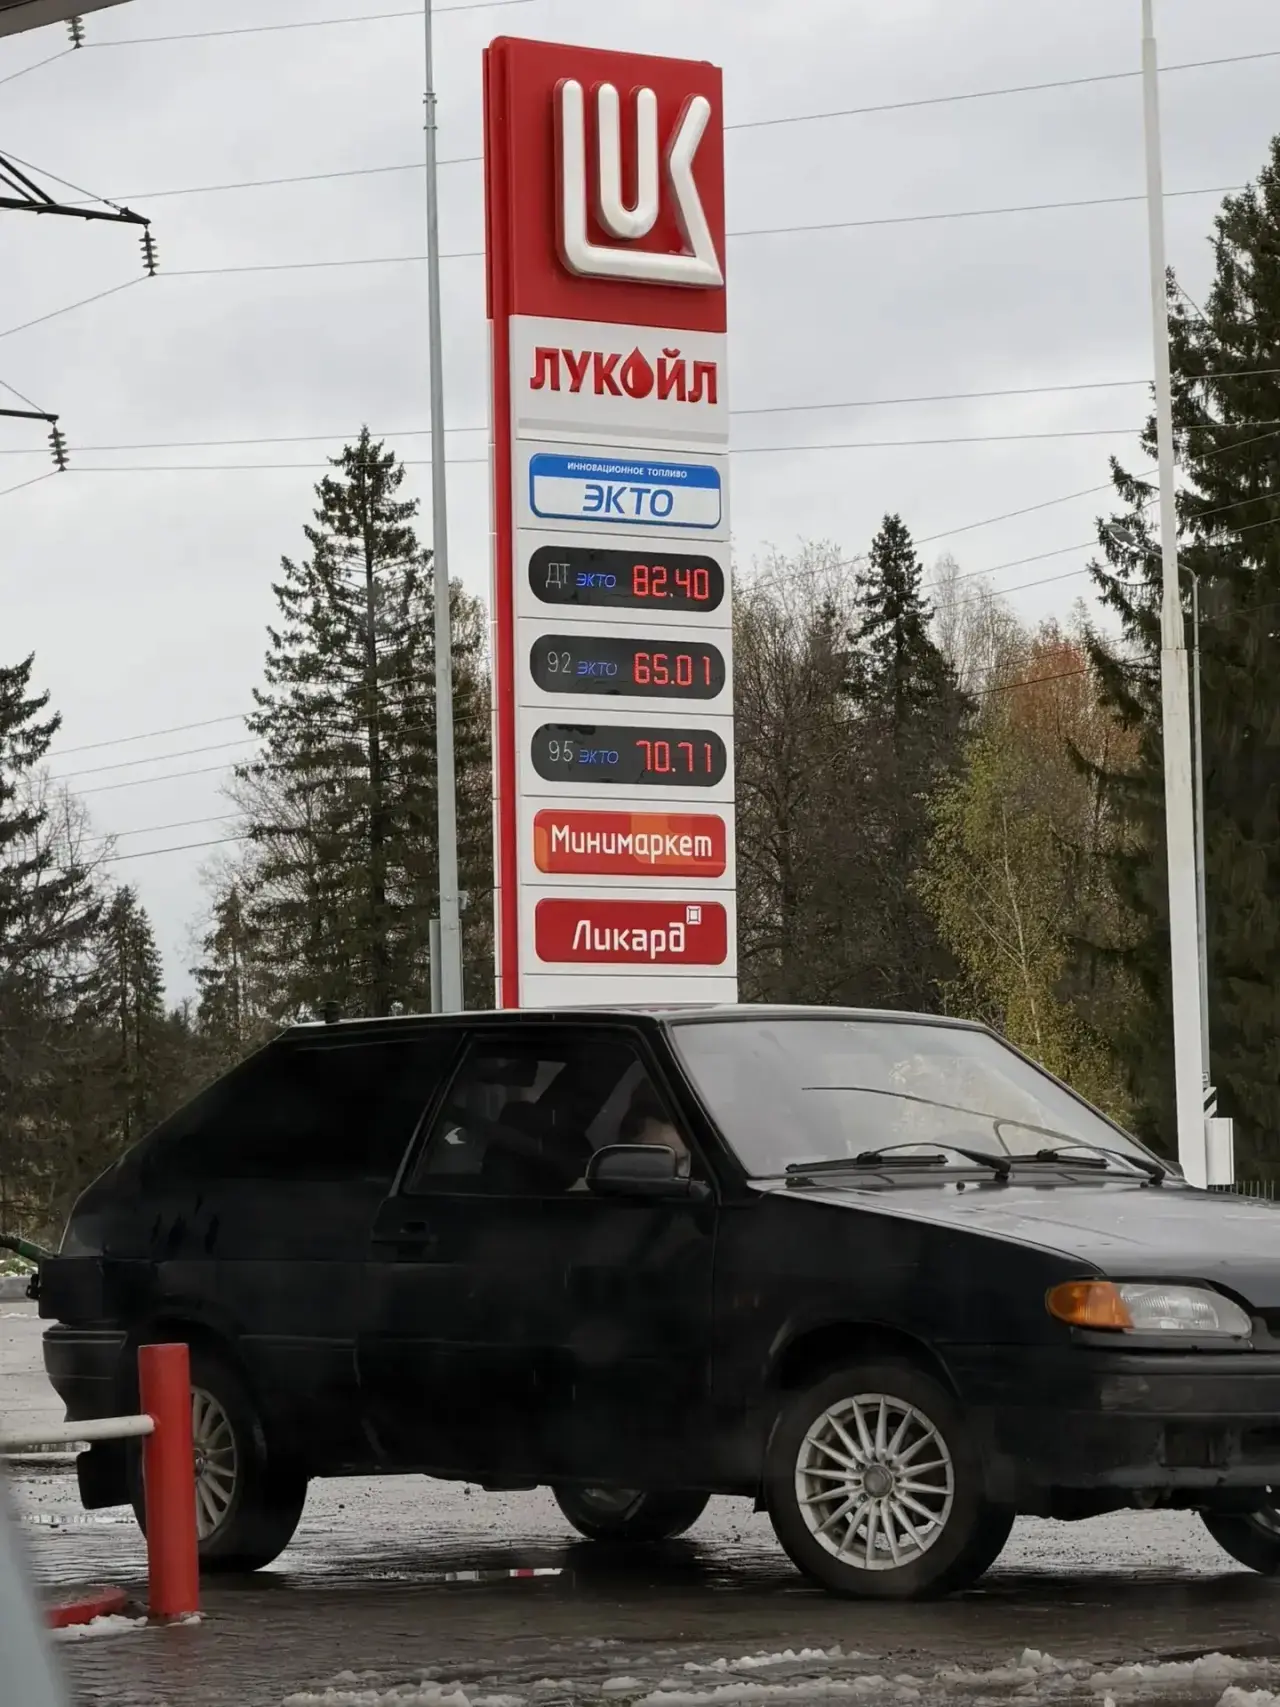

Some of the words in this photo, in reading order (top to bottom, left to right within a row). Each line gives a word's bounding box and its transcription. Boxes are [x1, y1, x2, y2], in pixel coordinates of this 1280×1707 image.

[530, 346, 718, 404] ЛУКОЙЛ
[567, 462, 644, 476] ИННОВАЦИОННОЕ
[648, 467, 688, 479] ТОПЛИВО
[582, 484, 674, 517] ЭКТО
[545, 562, 571, 589] ДТ
[576, 572, 617, 588] ЭКТО
[632, 564, 710, 600] 82.40
[547, 651, 572, 674] 92
[576, 661, 618, 676] ЭКТО
[633, 652, 711, 686] 65.01
[548, 740, 574, 762] 95
[578, 750, 620, 764] ЭКТО
[635, 740, 712, 773] 70.71
[551, 824, 713, 864] Минимаркет
[572, 919, 686, 960] Ликард
